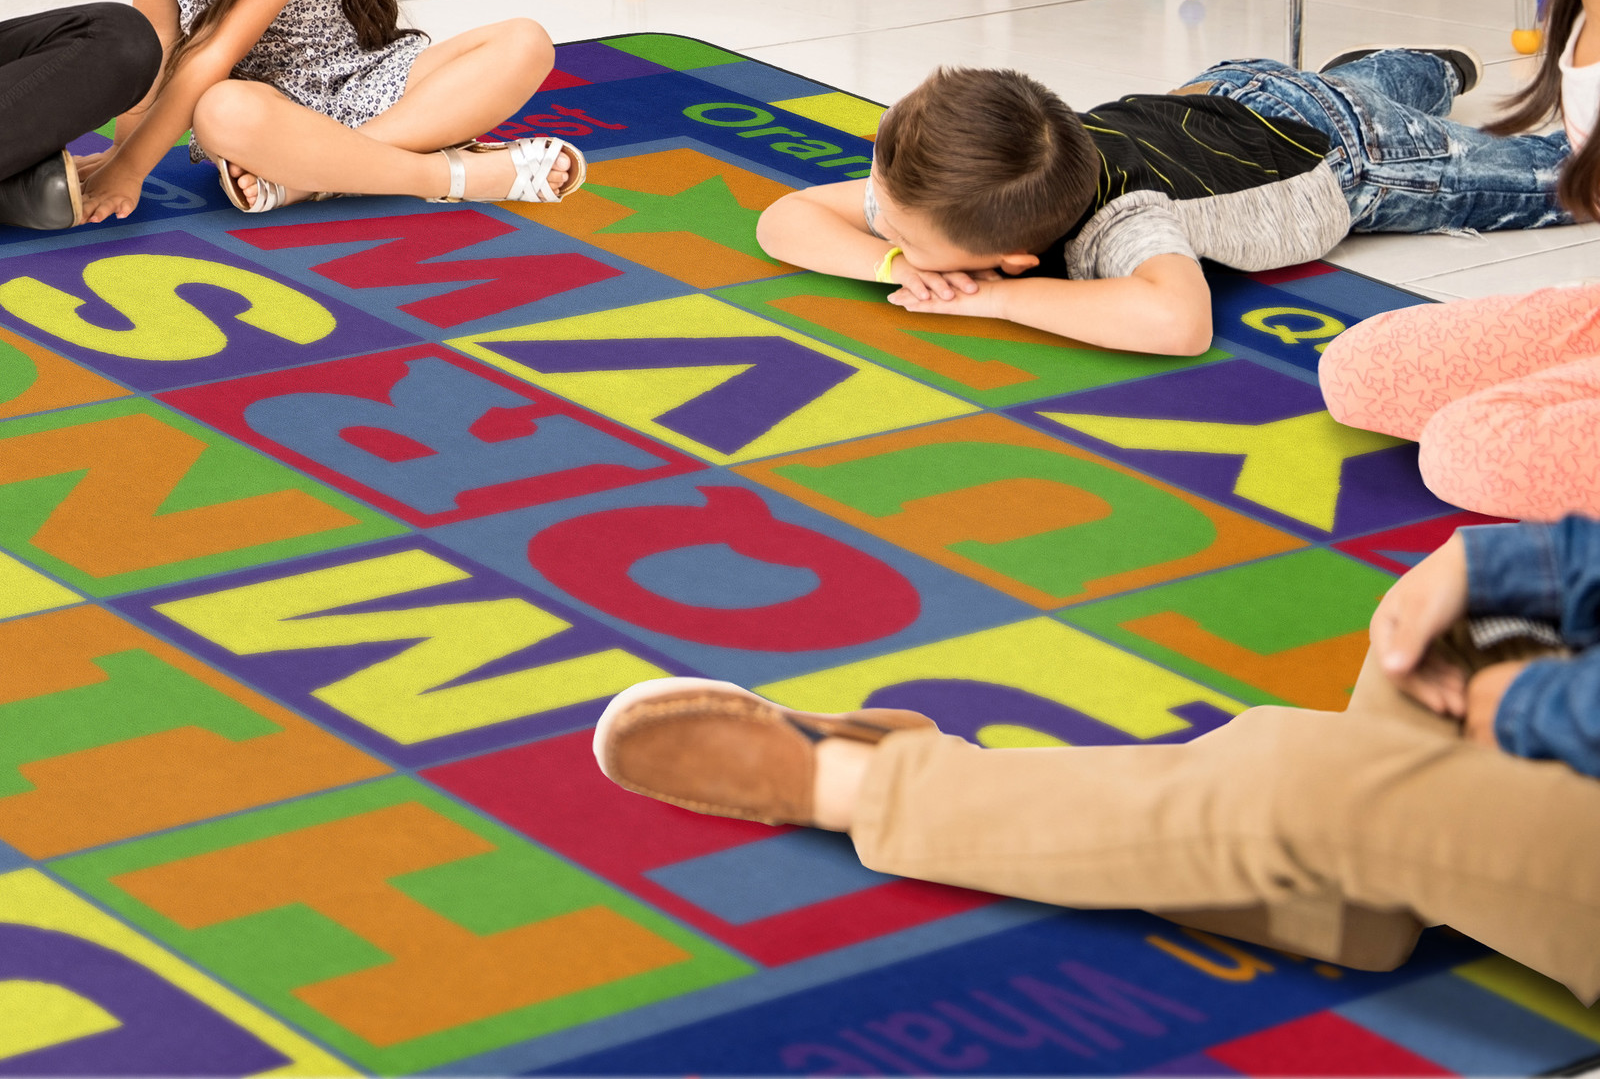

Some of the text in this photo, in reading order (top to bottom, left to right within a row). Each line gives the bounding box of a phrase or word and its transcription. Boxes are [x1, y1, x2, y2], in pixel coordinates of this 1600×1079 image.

[476, 104, 629, 143] est
[682, 102, 872, 179] Oran
[224, 209, 626, 329] W
[243, 356, 672, 516] R
[473, 335, 860, 457] V
[771, 441, 1218, 598] U
[1034, 411, 1419, 533] Y
[527, 486, 921, 651] Q
[151, 549, 676, 745] M
[107, 800, 694, 1048] H
